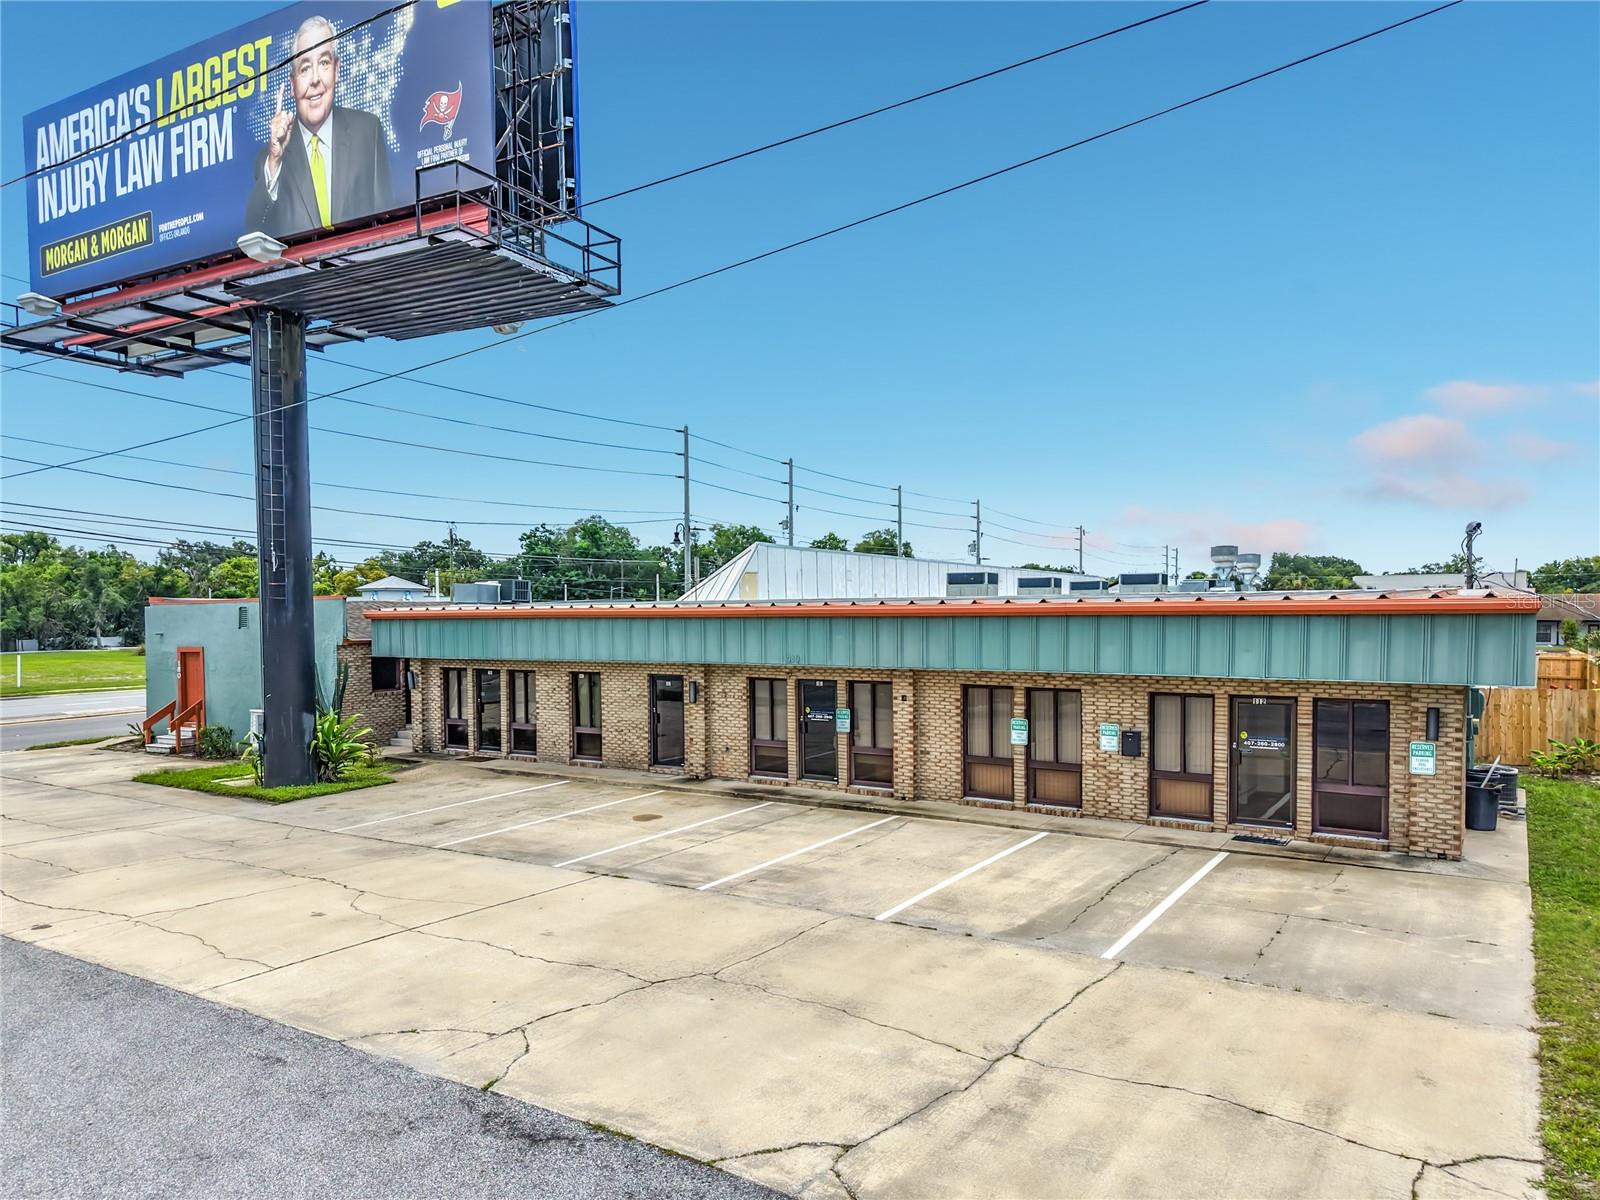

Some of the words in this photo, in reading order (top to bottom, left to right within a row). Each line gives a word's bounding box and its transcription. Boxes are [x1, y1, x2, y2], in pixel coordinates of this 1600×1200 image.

[36, 83, 150, 176] AMERICA'S
[155, 35, 273, 129] LARGEST
[37, 152, 109, 224] INJURY
[114, 131, 165, 197] LAW
[170, 107, 233, 178] FIRM
[45, 235, 88, 272] MORGAN
[91, 234, 99, 258] &
[101, 218, 147, 255] MORGAN
[158, 211, 204, 233] FORTHEPEOPLE.COM
[159, 230, 174, 242] OFFICES
